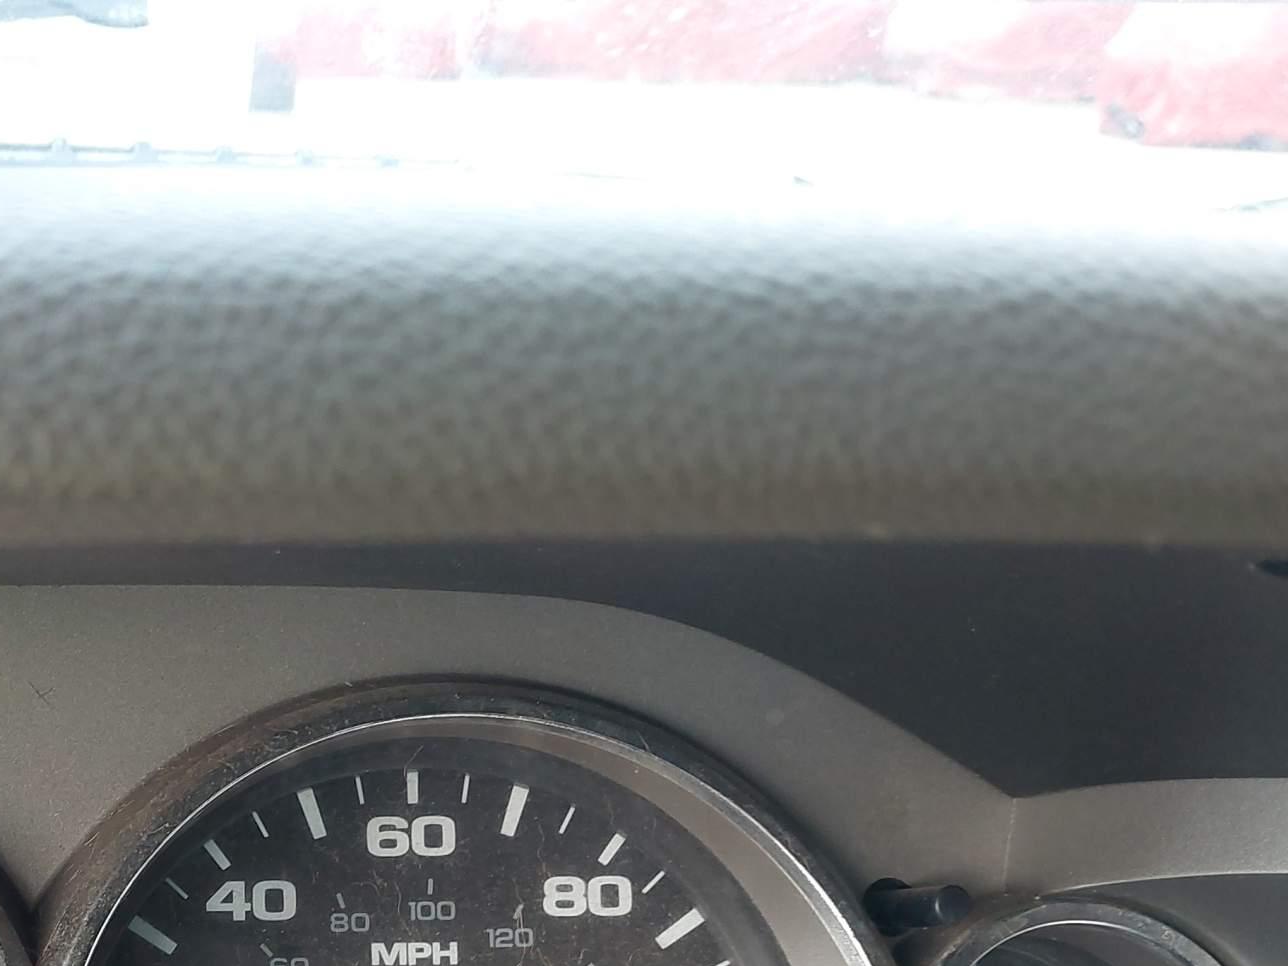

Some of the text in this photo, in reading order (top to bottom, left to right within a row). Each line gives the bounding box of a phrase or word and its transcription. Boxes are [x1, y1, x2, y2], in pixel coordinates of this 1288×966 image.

[366, 815, 457, 858] 60
[205, 879, 298, 922] 40
[542, 875, 633, 918] 80
[329, 913, 371, 934] 80
[407, 901, 457, 923] 100
[485, 928, 535, 949] 120
[370, 941, 459, 966] MPH
